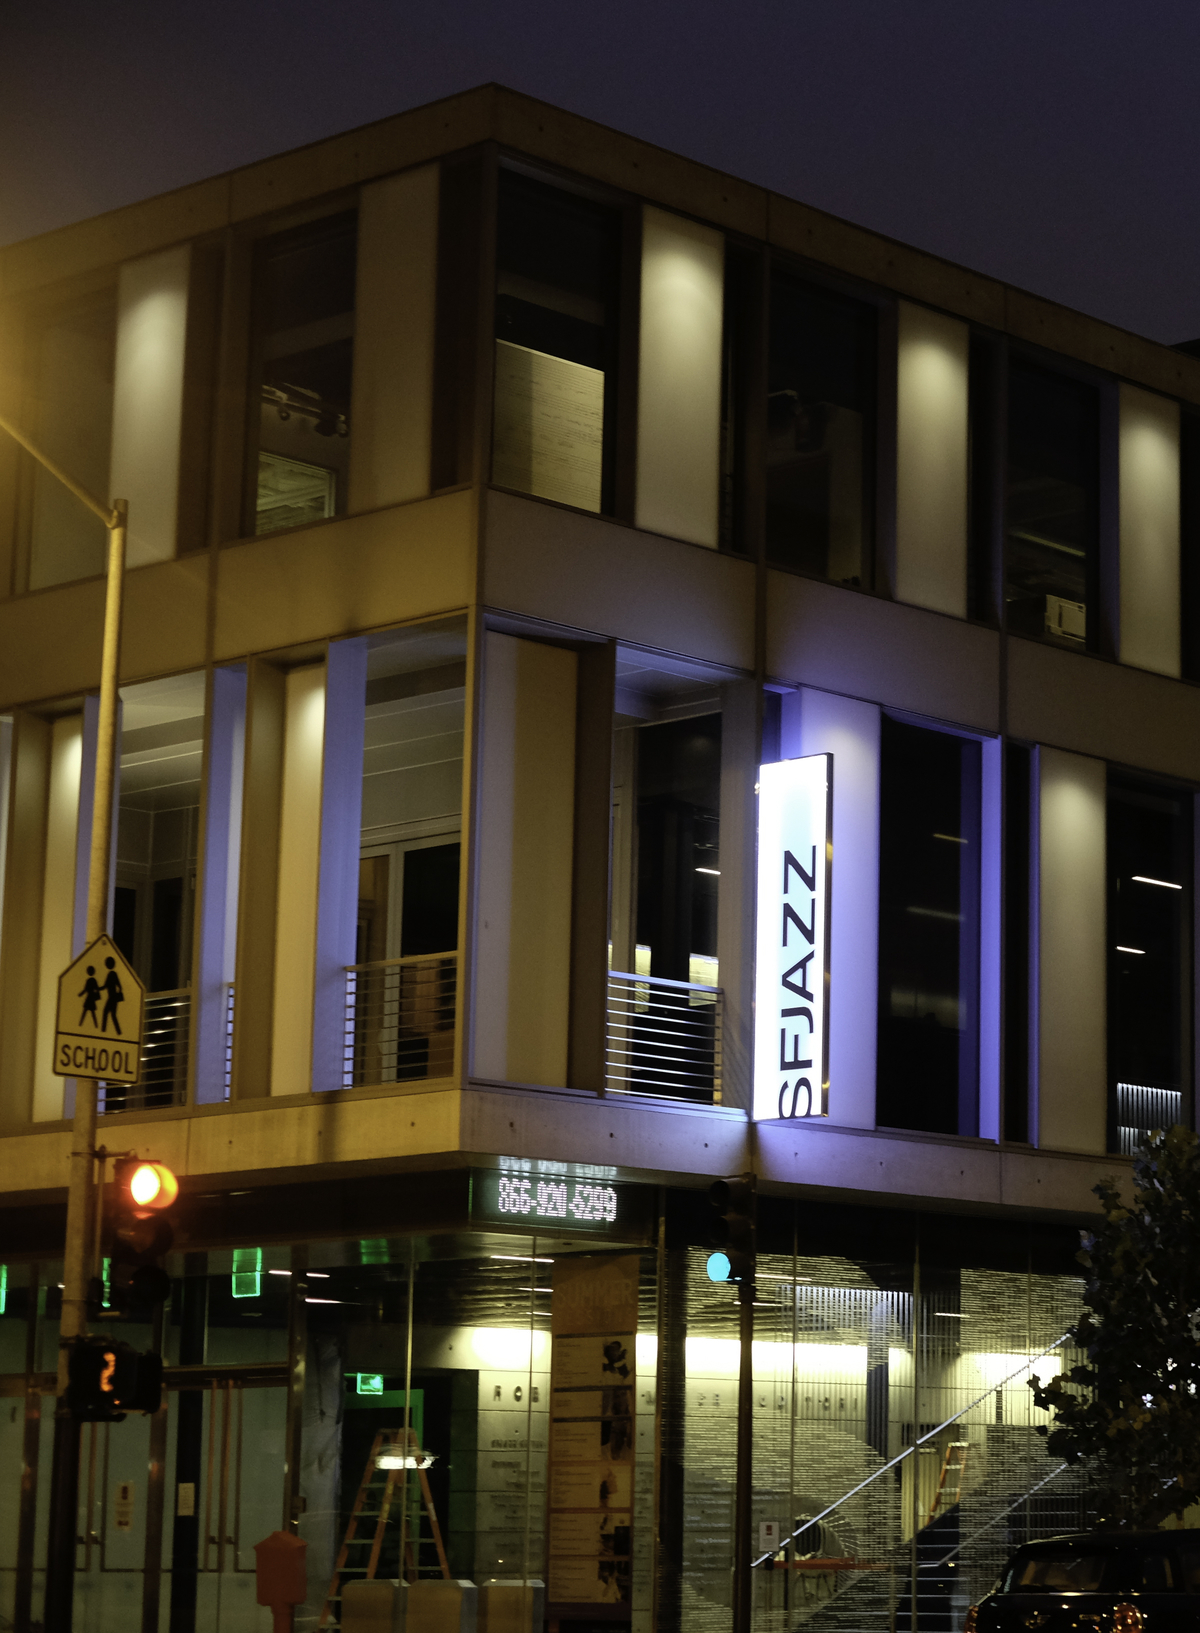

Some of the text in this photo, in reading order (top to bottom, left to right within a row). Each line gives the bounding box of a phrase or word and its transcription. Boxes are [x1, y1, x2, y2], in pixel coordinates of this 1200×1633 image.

[778, 845, 817, 1119] SFJAZZ
[60, 1044, 134, 1075] SCHOOL
[555, 1279, 634, 1309] SUMMER
[493, 1386, 539, 1403] ROB
